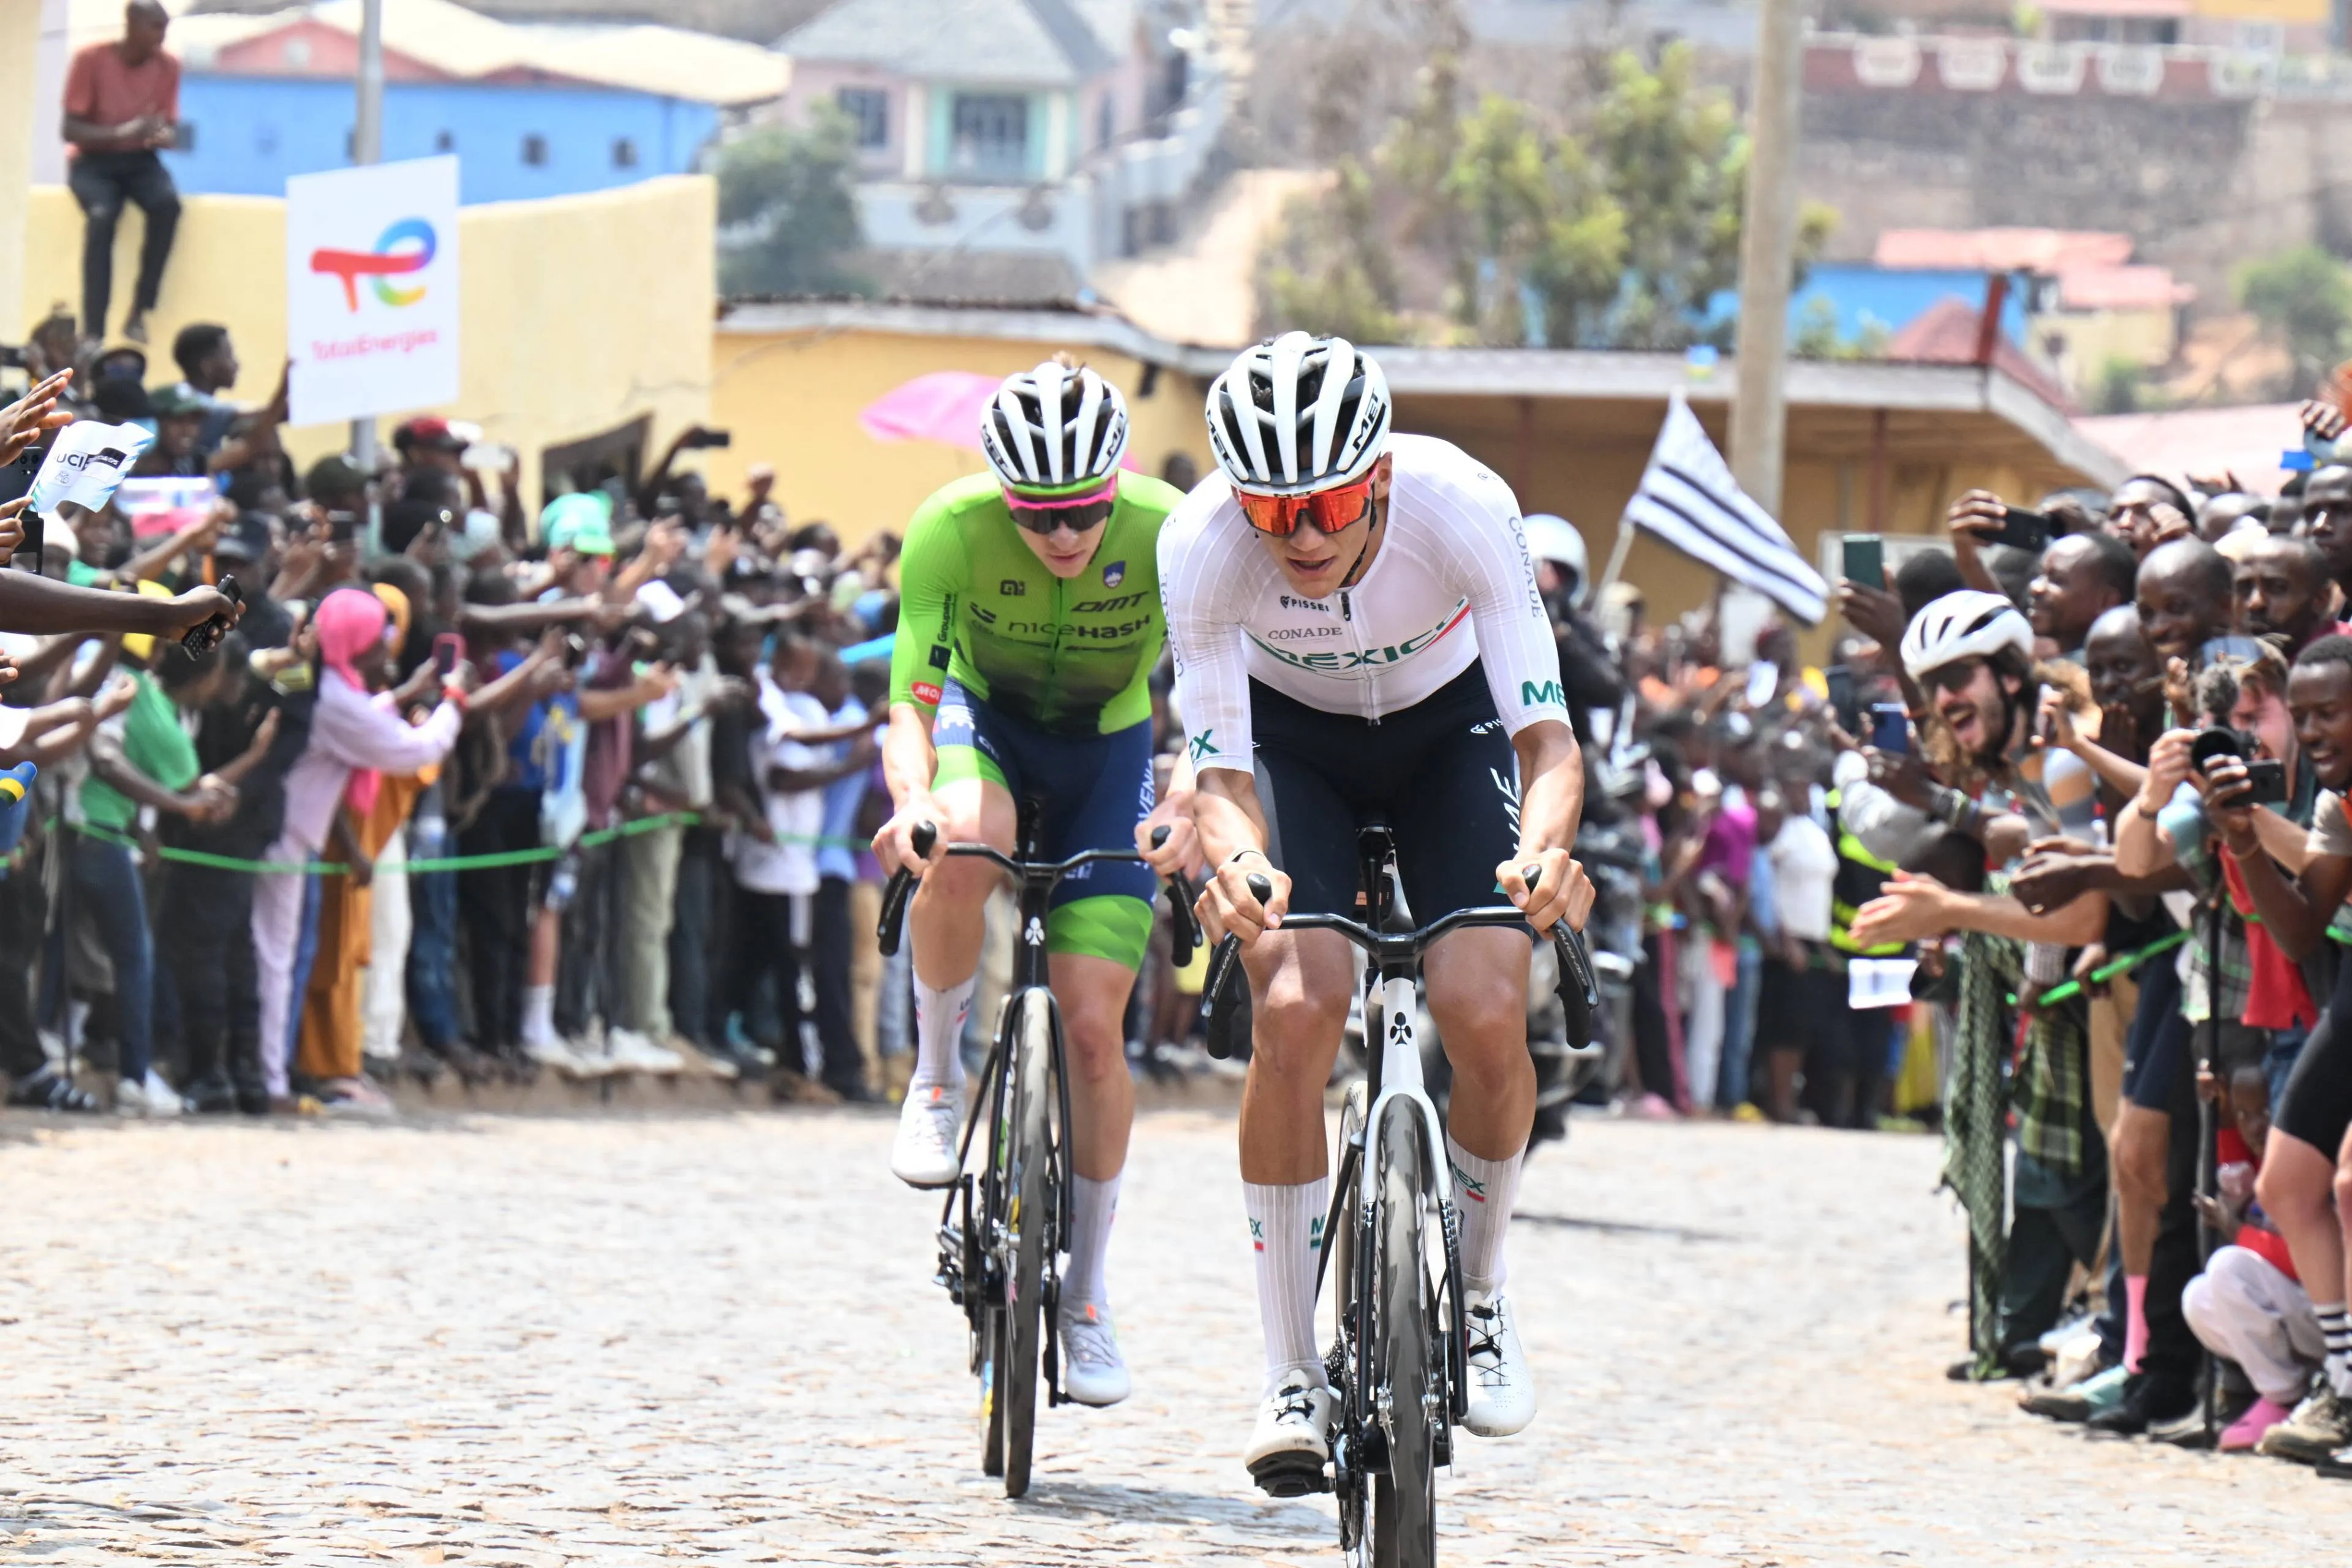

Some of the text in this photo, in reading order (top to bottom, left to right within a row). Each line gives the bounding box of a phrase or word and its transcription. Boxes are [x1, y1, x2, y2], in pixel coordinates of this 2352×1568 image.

[1352, 387, 1379, 451] MET
[1206, 409, 1234, 467] MET
[56, 453, 85, 467] UCI
[1070, 590, 1150, 612] DMT
[1291, 598, 1330, 612] PISSEI
[1268, 627, 1343, 640] CONADE
